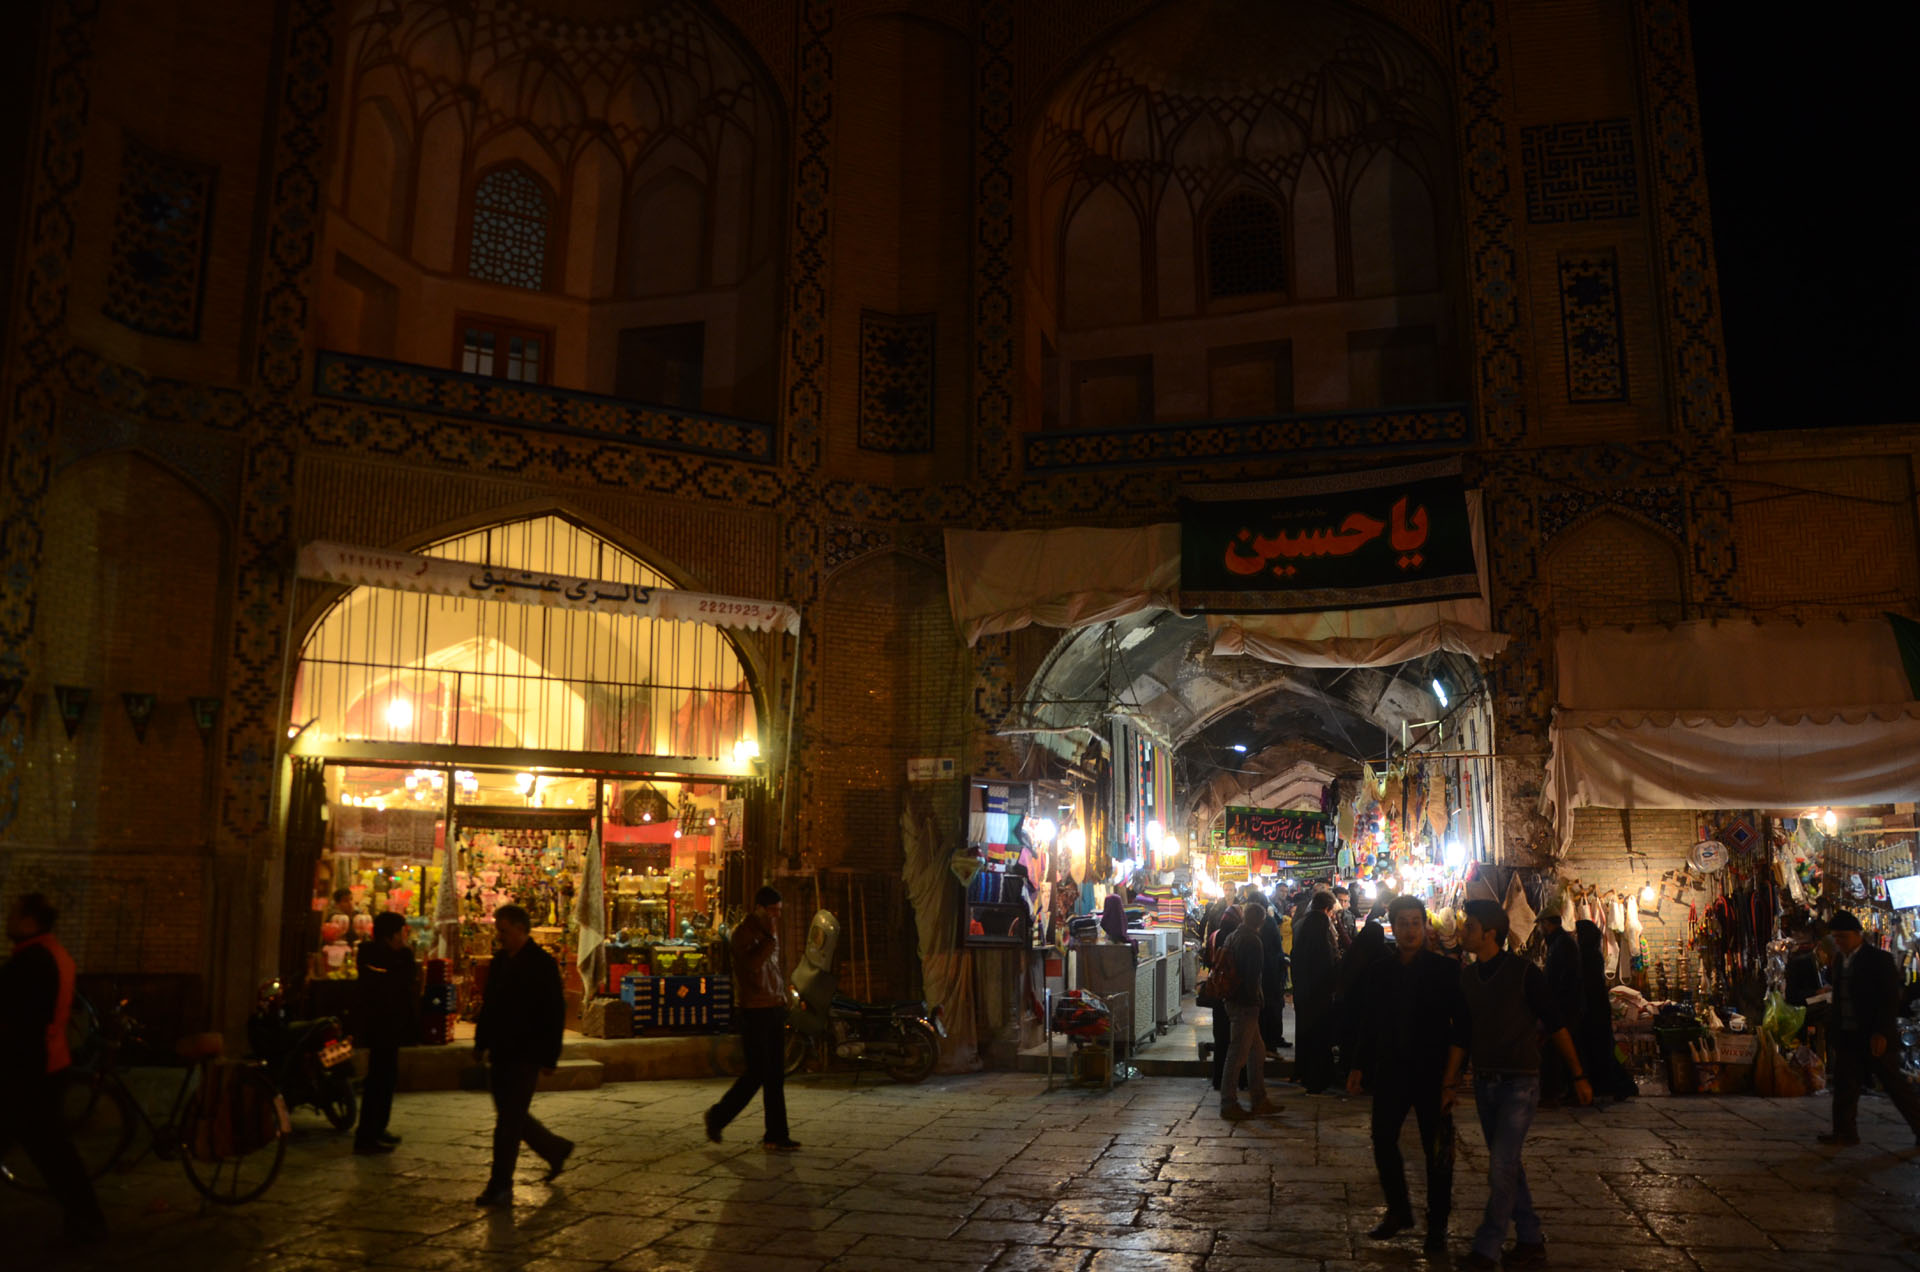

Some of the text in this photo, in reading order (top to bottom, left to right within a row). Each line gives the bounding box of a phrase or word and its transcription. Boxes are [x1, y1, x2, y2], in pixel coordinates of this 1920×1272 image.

[1223, 495, 1429, 576] یا حسین
[469, 571, 561, 593] عتیق
[698, 600, 760, 617] 2221923
